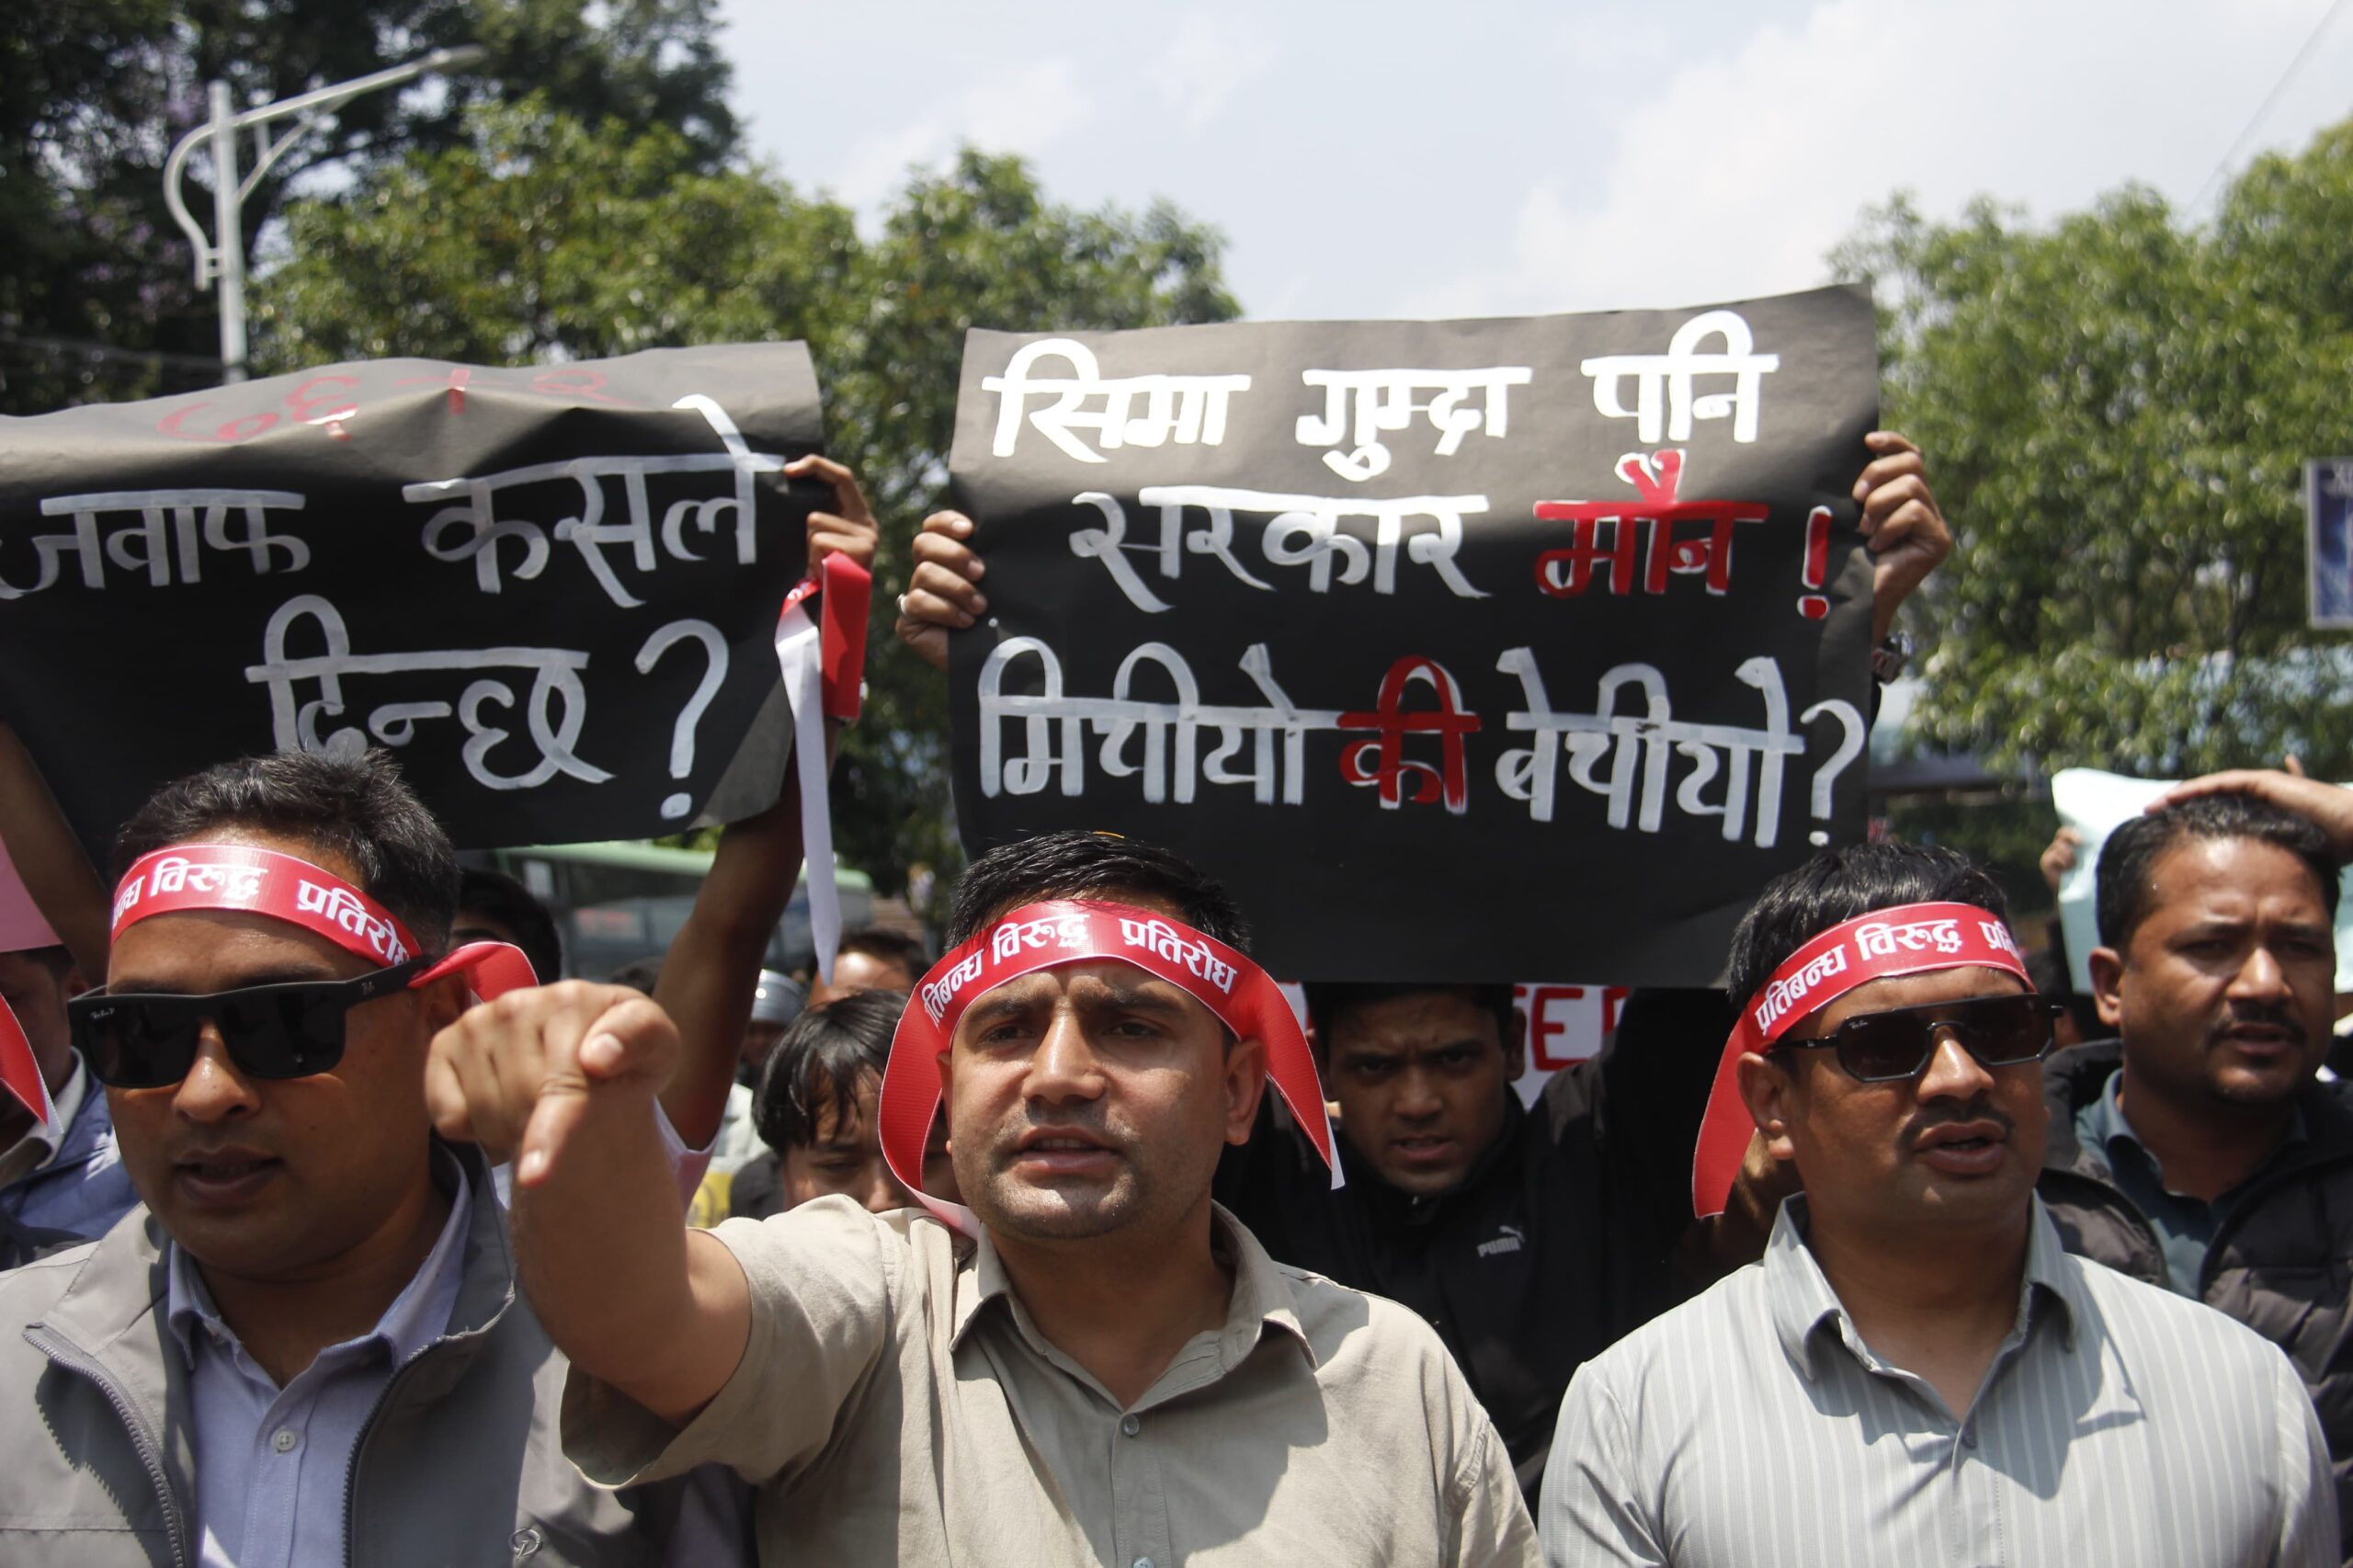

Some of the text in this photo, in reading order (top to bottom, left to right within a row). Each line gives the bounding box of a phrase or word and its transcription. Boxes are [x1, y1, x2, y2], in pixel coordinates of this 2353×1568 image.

[982, 310, 1779, 482] सिमा गुम्दा पनि
[402, 393, 785, 608] कसले
[1069, 485, 1493, 613] सरकार
[1119, 917, 1238, 994] प्रतिरोध
